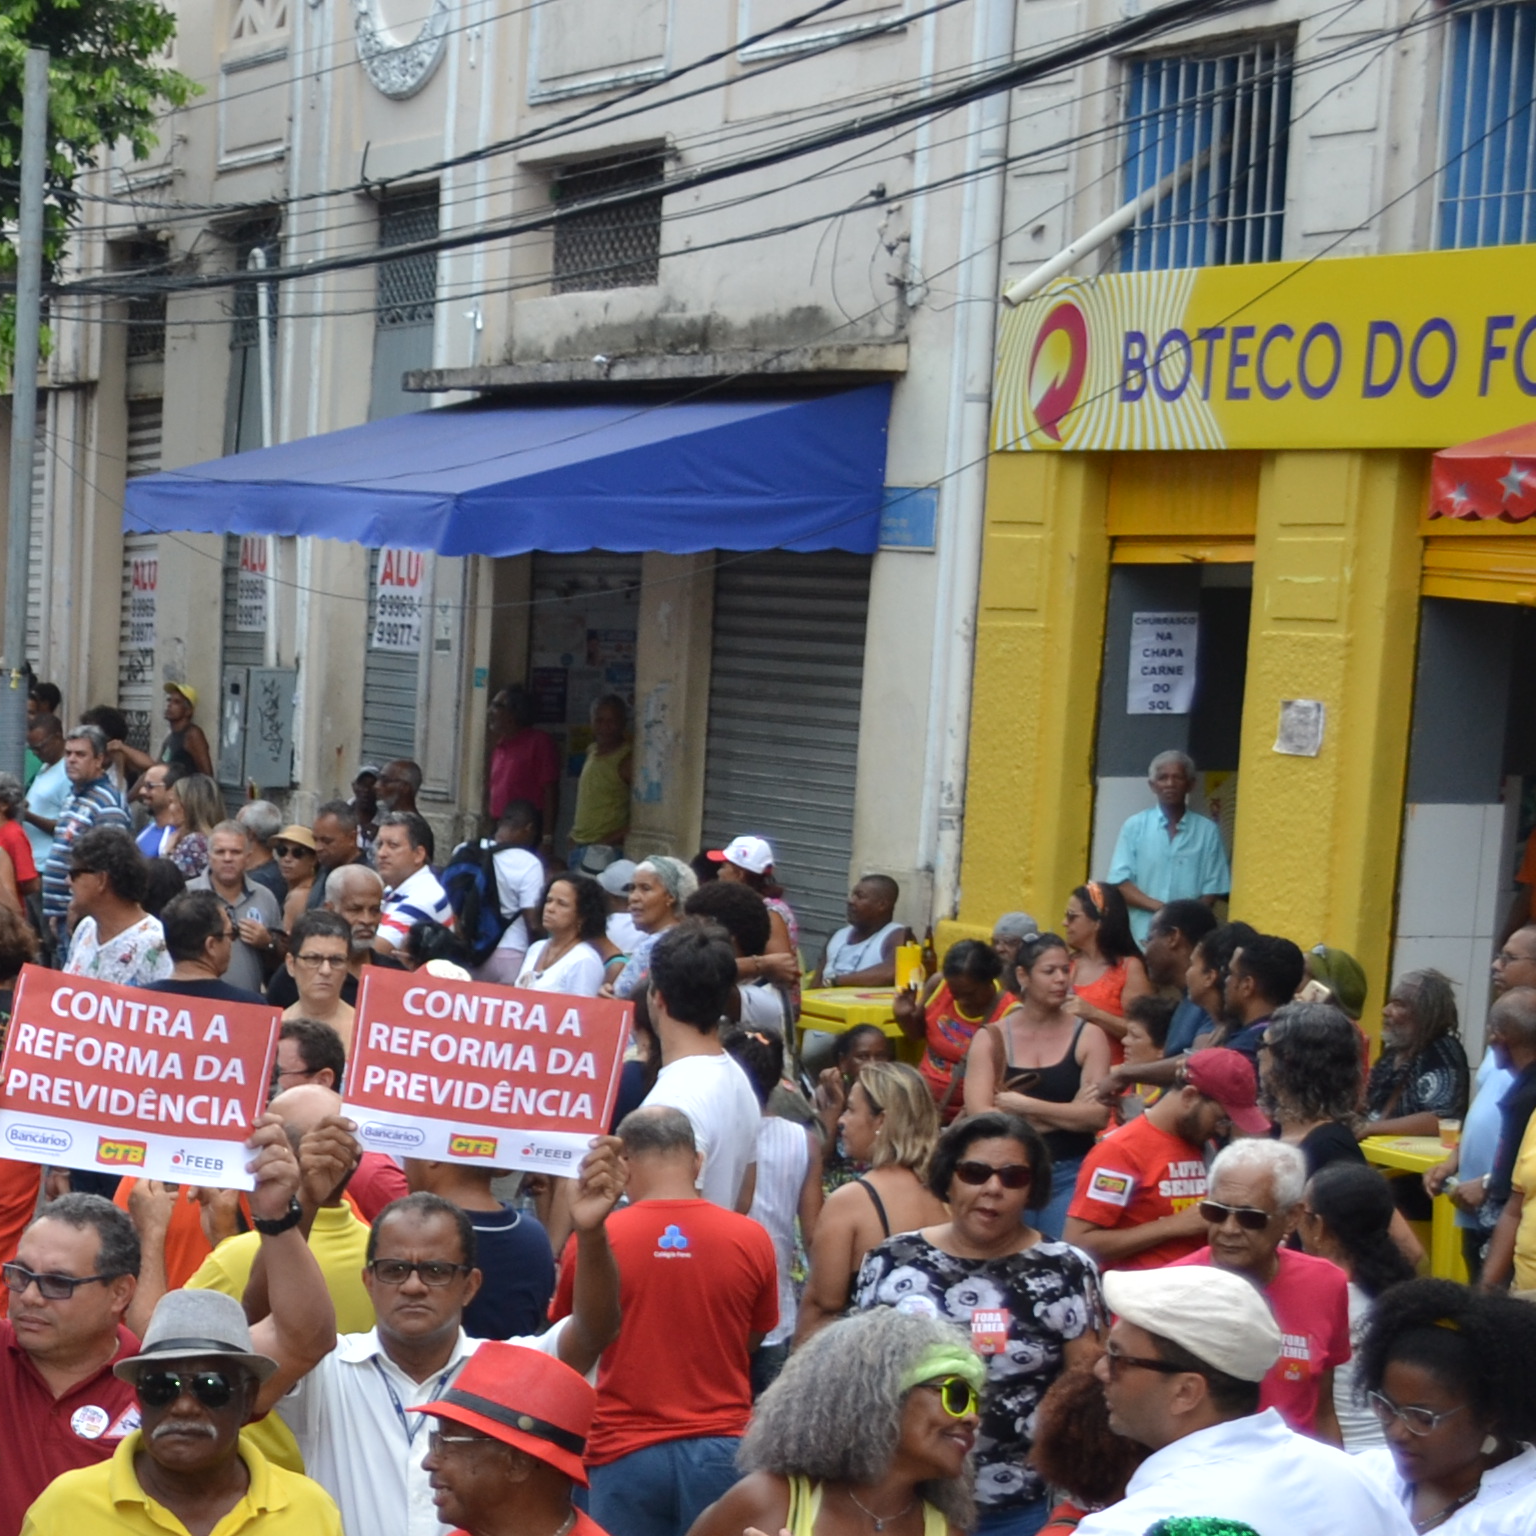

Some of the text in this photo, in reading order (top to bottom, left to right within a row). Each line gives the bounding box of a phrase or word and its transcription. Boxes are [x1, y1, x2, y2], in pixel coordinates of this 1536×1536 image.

[1119, 321, 1344, 403] BOTECO
[1362, 317, 1457, 399] DO
[1134, 616, 1197, 626] CHURRASCO
[1155, 631, 1172, 641] NA
[1142, 647, 1184, 658] CHAPA
[1141, 665, 1184, 676] CARNE
[1148, 700, 1172, 710] SOL
[1153, 683, 1170, 693] DO
[50, 986, 229, 1044] CONTRA A
[402, 987, 581, 1037] CONTRA A
[14, 1023, 246, 1085] REFORMA DA
[367, 1022, 597, 1080] REFORMA DA
[5, 1069, 246, 1128] PREVIDÊNCIA
[362, 1065, 593, 1120] PREVIDÊNCIA
[10, 1128, 224, 1171] Bancários CTB FEEB
[364, 1126, 572, 1160] Bancários CTB FEEB
[971, 1322, 1006, 1333] TEMER
[974, 1312, 1002, 1323] FORA
